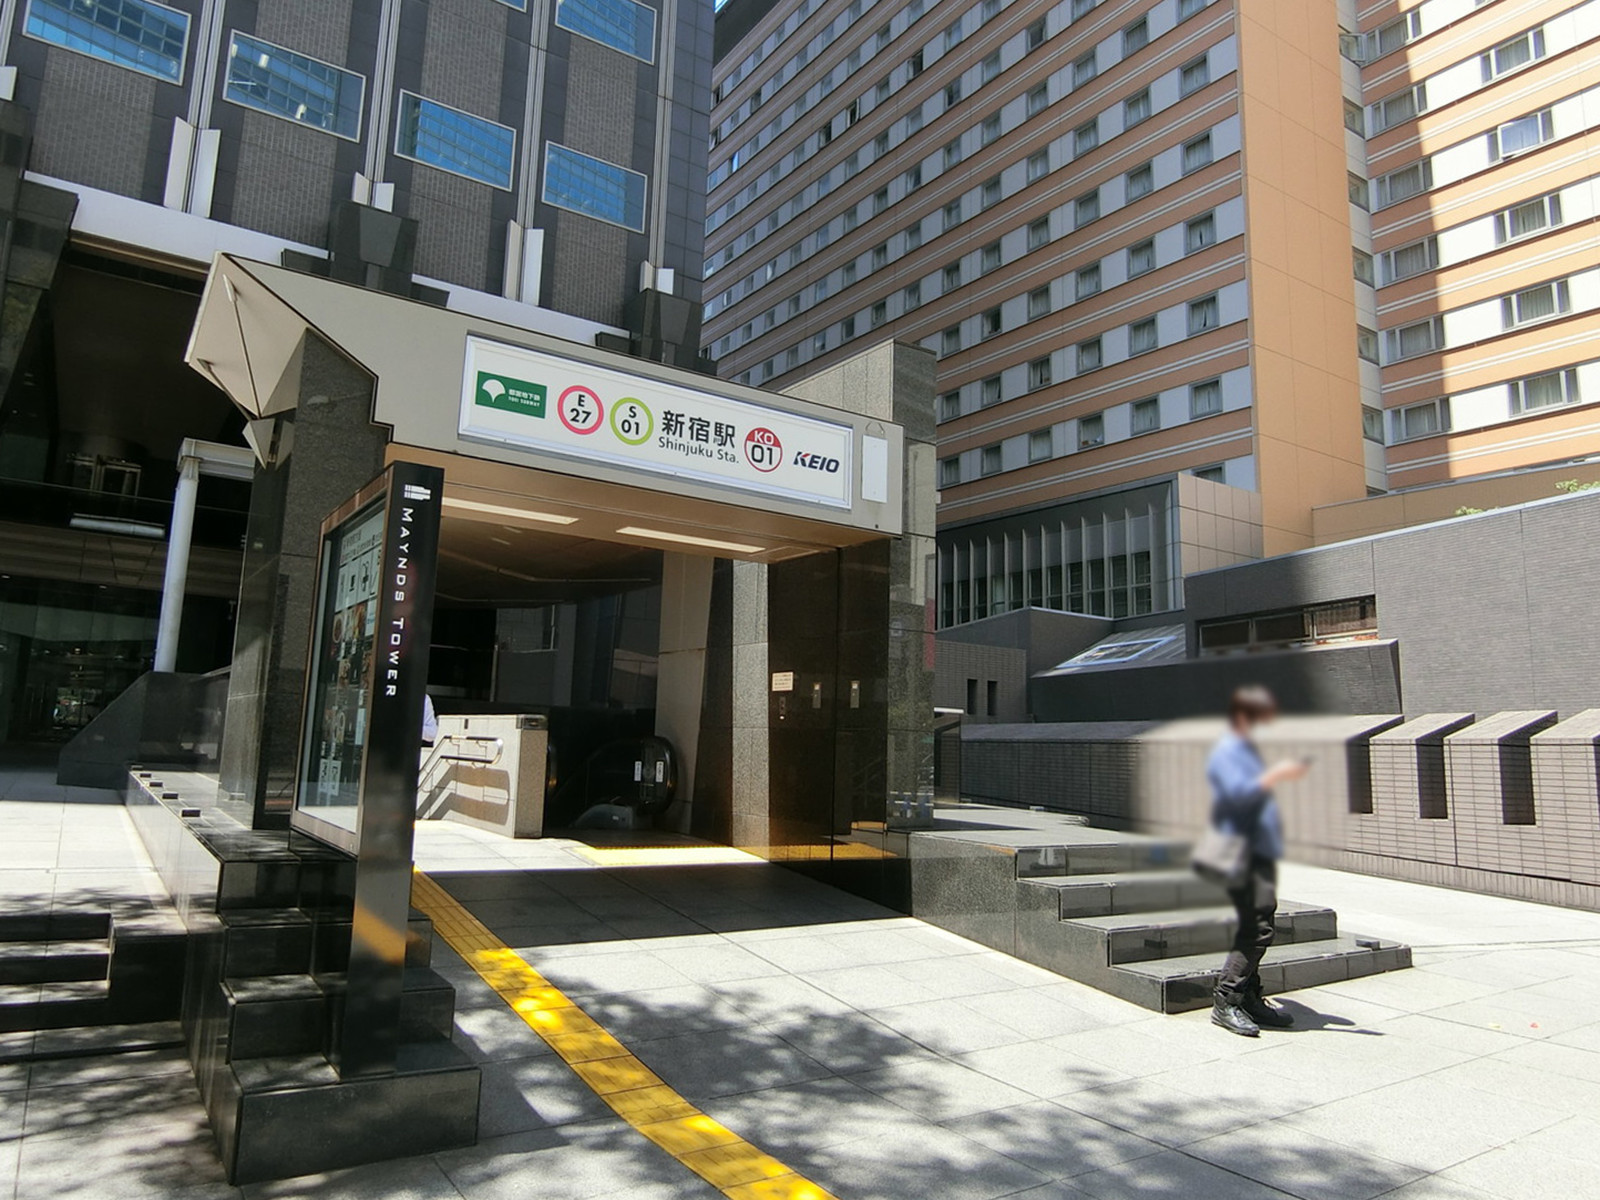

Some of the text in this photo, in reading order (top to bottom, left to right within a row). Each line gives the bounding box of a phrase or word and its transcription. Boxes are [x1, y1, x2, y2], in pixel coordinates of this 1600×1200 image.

[577, 393, 586, 408] E
[569, 407, 592, 424] 27
[627, 405, 638, 419] S
[621, 419, 640, 435] 01
[661, 409, 736, 448] 新宿駅
[754, 430, 775, 445] KO
[658, 436, 740, 464] Shinjuku Sta.
[751, 444, 773, 466] 01
[793, 451, 840, 473] KEIO
[385, 507, 414, 696] MAYNDS TOWER
